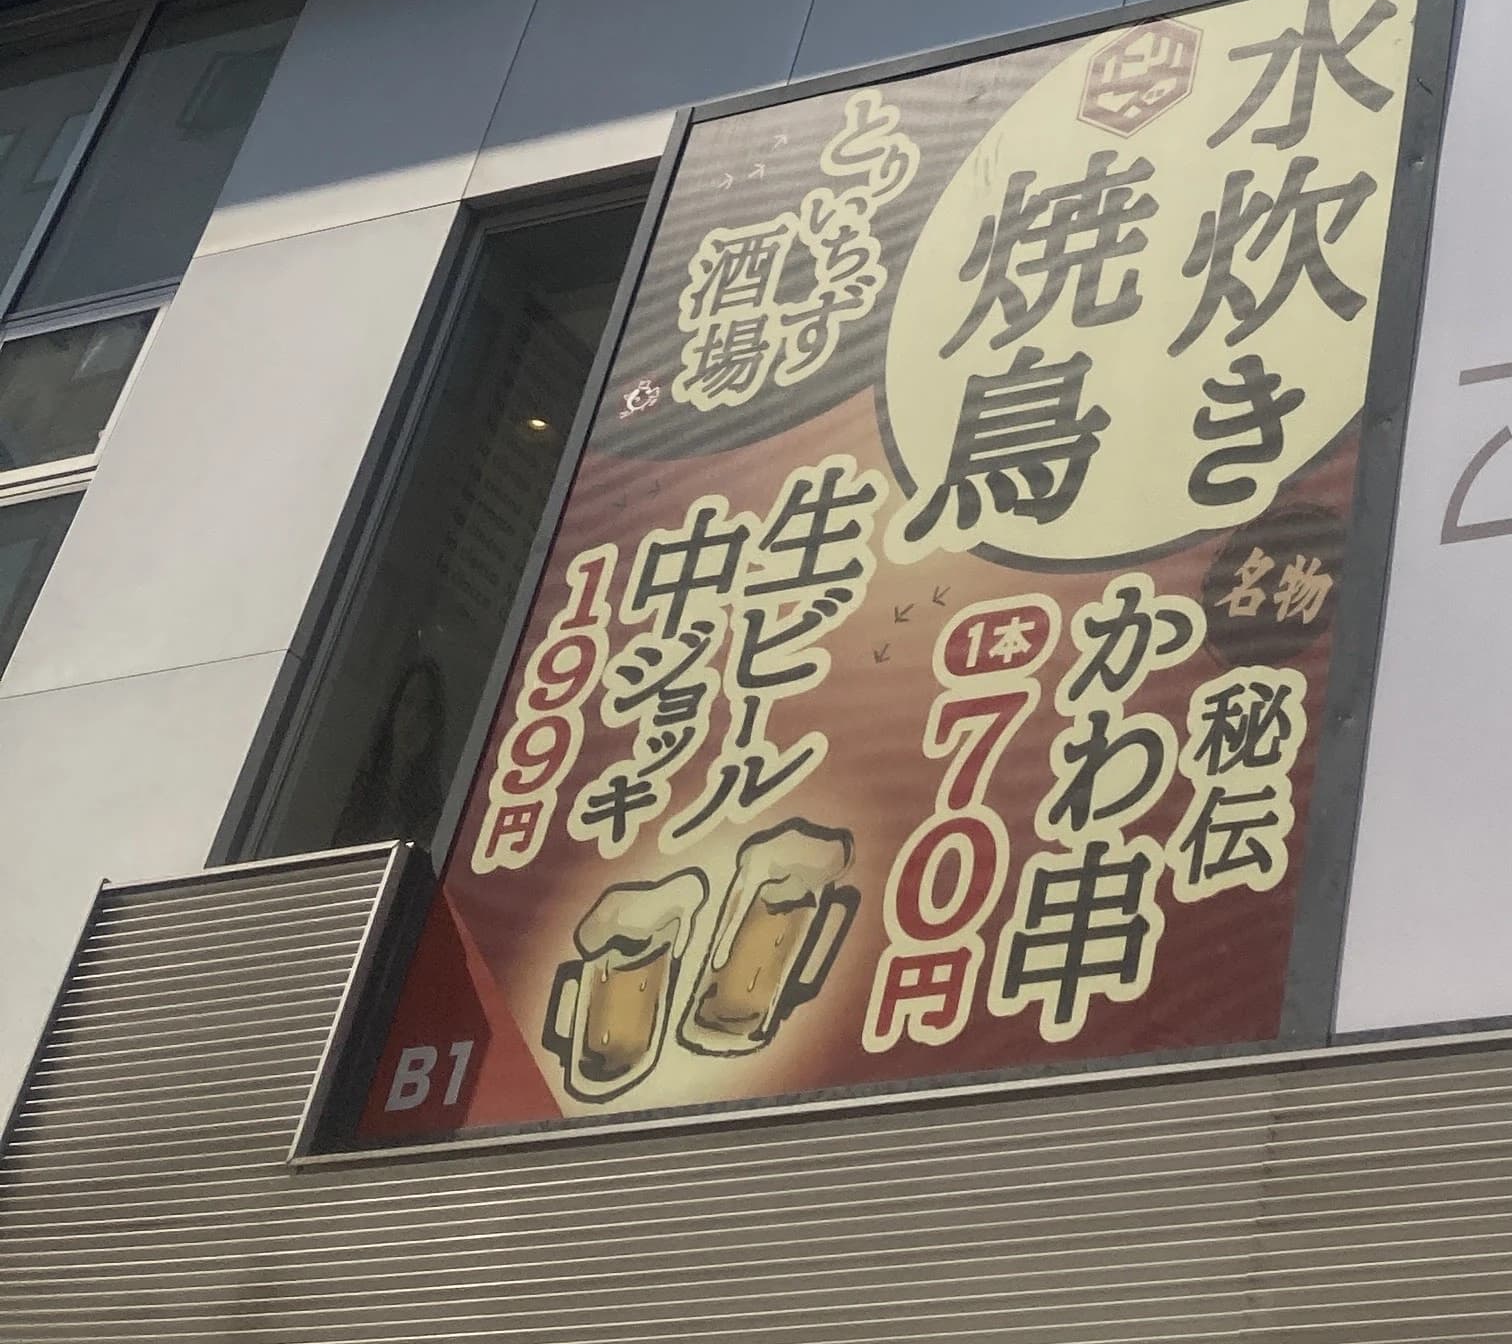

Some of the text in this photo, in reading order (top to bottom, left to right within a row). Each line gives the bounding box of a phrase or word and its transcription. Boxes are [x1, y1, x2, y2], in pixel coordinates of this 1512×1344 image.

[683, 222, 790, 399] 酒場
[904, 149, 1161, 543] 焼鳥
[484, 555, 606, 859] 199円
[580, 507, 750, 843] 中ジョッキ
[671, 466, 878, 840] 生ビール
[965, 616, 1033, 669] 1本
[1214, 546, 1333, 625] 名物
[875, 690, 1030, 1039] 70円
[1001, 586, 1194, 1025] かわ串
[1180, 680, 1293, 885] 秘伝
[384, 1040, 474, 1113] B1
